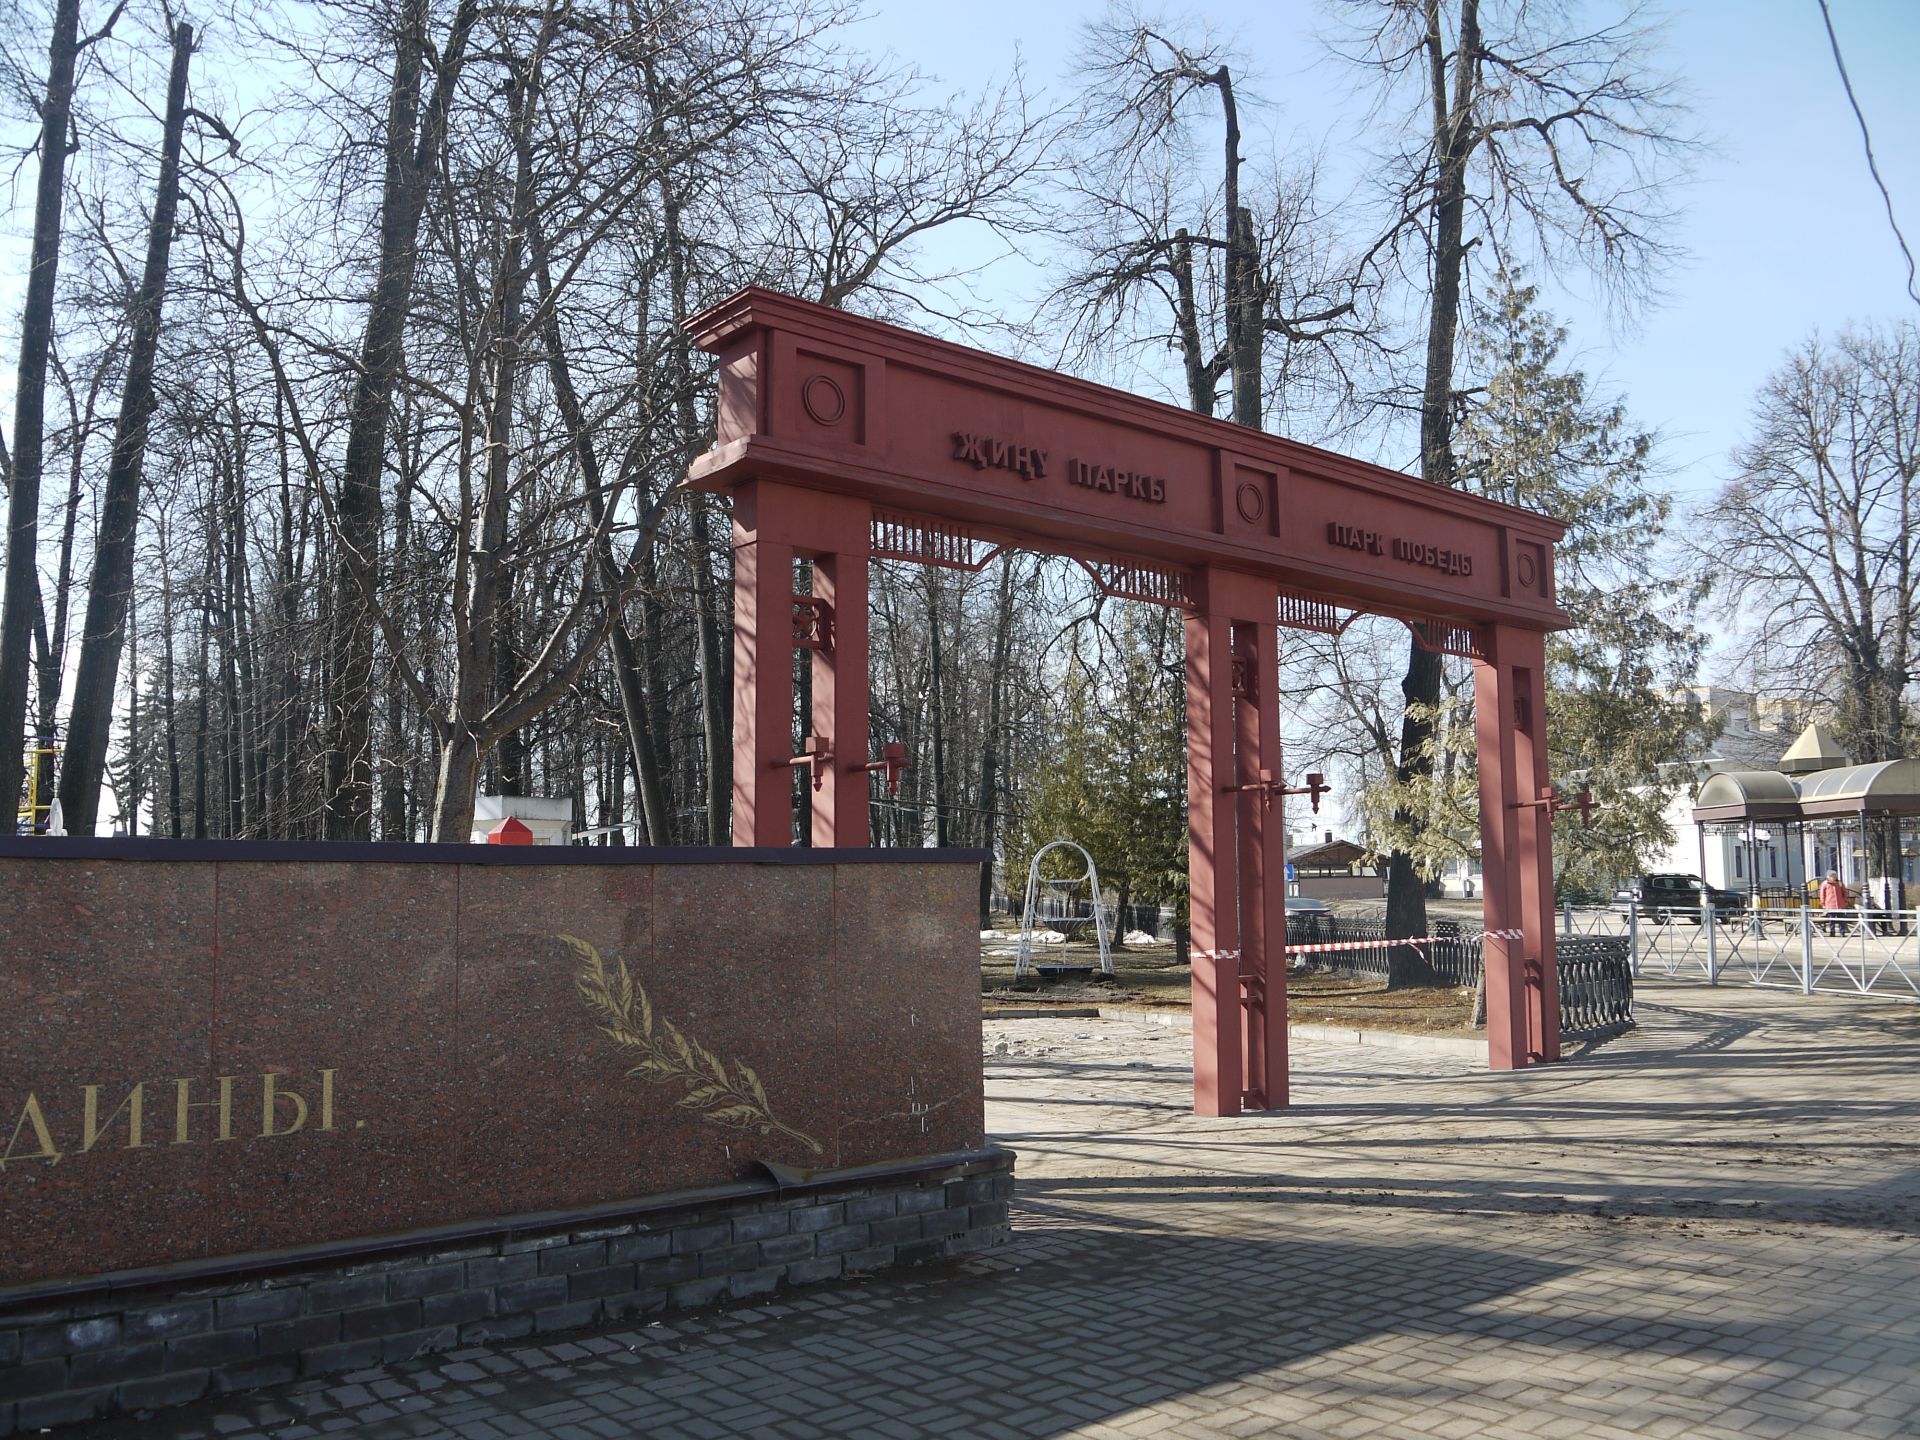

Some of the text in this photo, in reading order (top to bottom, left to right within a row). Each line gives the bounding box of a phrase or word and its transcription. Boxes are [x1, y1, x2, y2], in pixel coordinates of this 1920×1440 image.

[1071, 457, 1168, 502] ПАРКЫ
[1329, 522, 1474, 576] ПАРК ПОБЕДЫ
